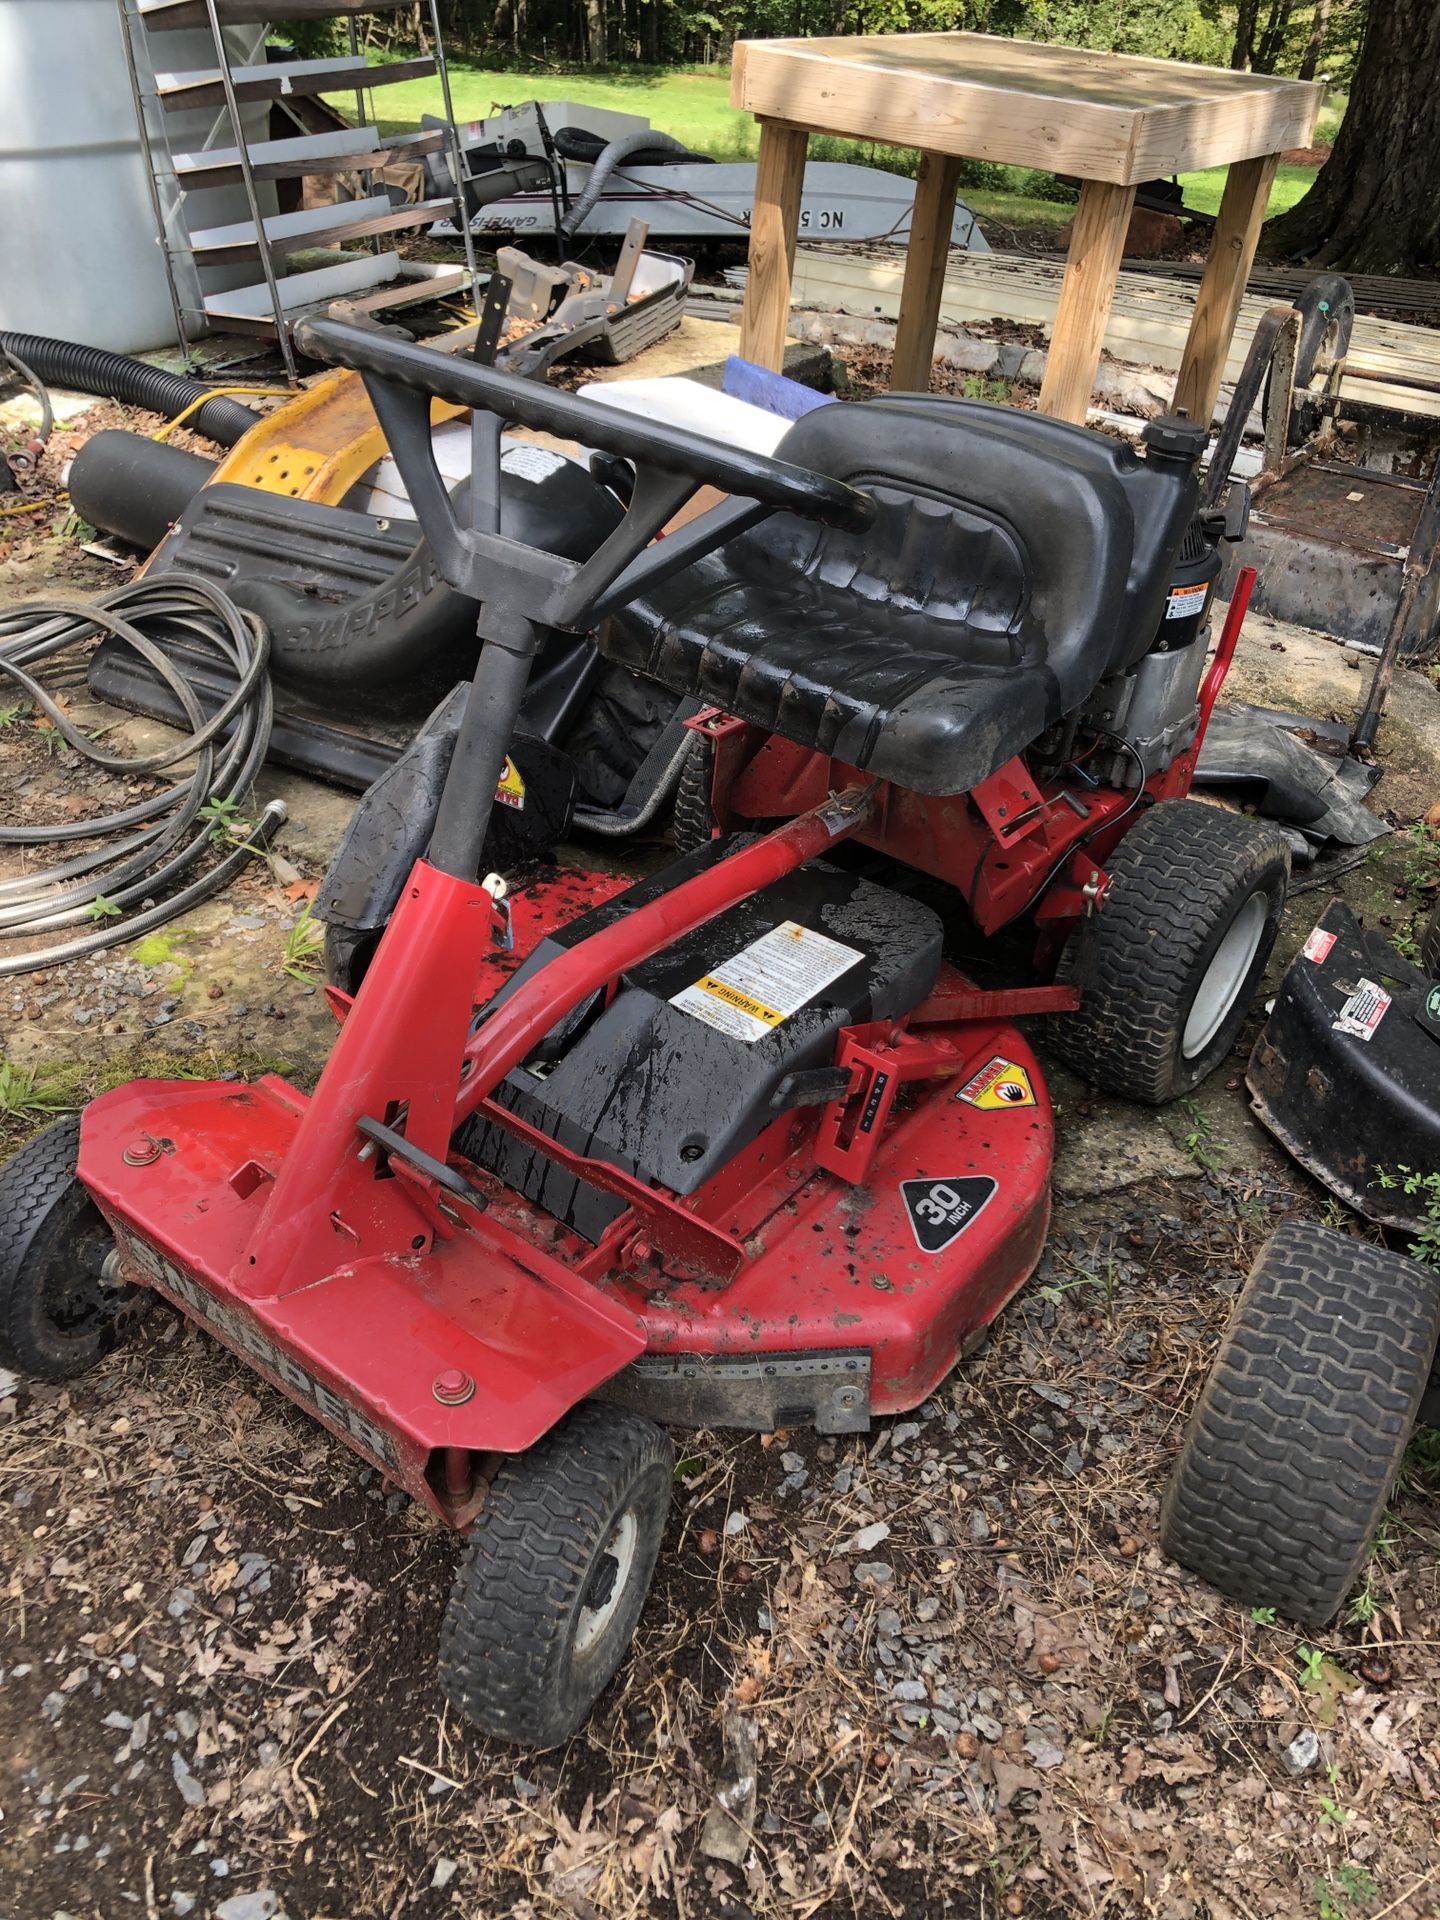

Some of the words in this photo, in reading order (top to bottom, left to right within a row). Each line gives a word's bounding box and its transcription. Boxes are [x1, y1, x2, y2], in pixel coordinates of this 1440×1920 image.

[441, 216, 538, 227] GAMEFISR
[820, 211, 843, 228] NC
[715, 987, 761, 1013] WARNING
[962, 1060, 1005, 1097] DANGER
[915, 1183, 961, 1226] 30
[946, 1201, 972, 1226] INCH
[128, 1235, 388, 1461] SNAPPER
